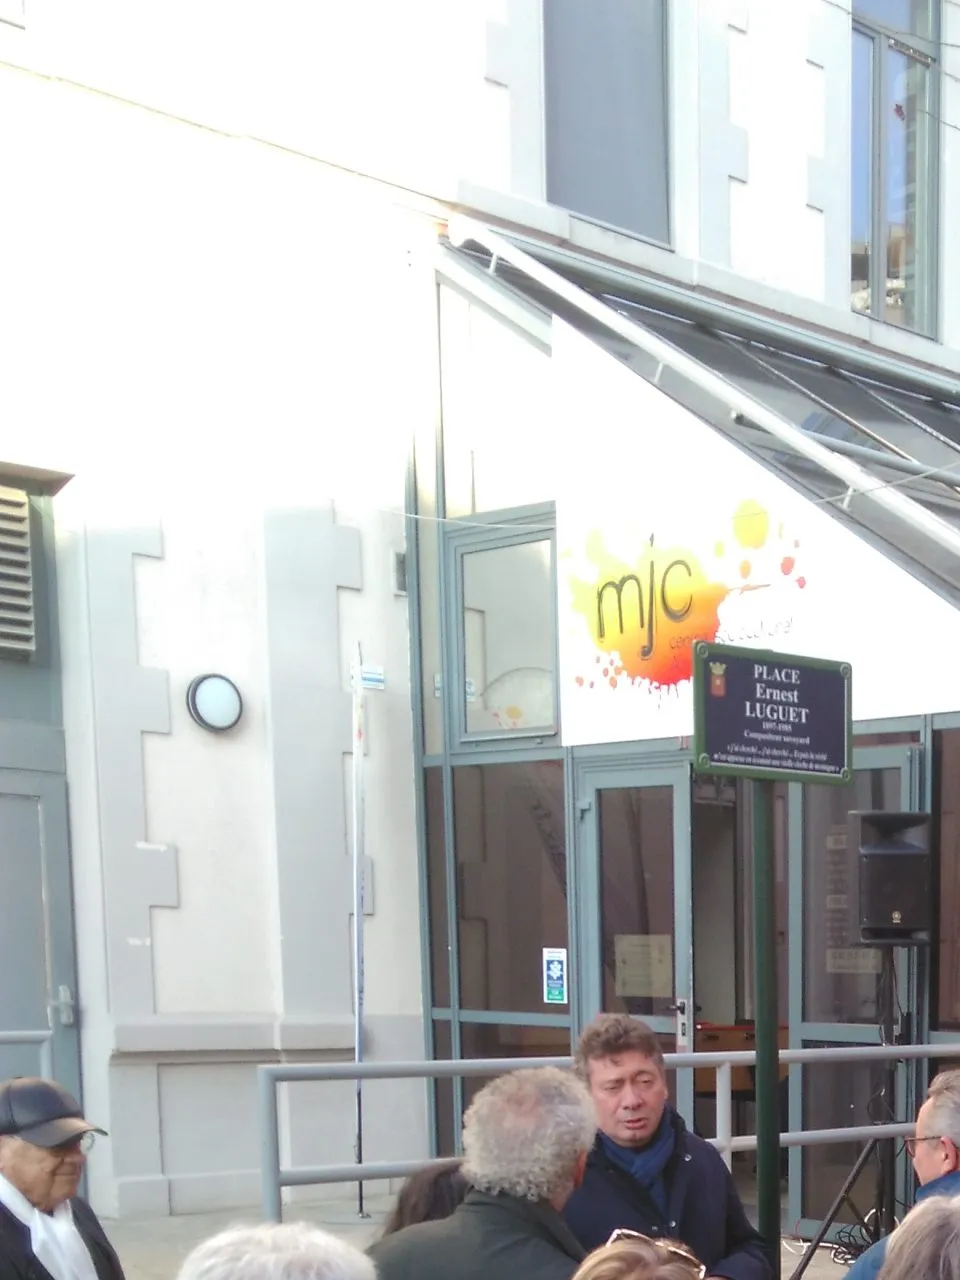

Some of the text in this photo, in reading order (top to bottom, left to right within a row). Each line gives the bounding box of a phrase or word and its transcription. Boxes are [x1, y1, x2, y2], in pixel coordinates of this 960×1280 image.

[597, 533, 693, 660] mjc
[753, 663, 801, 685] PLACE
[755, 682, 799, 704] Ernest
[744, 701, 810, 724] LUGUET
